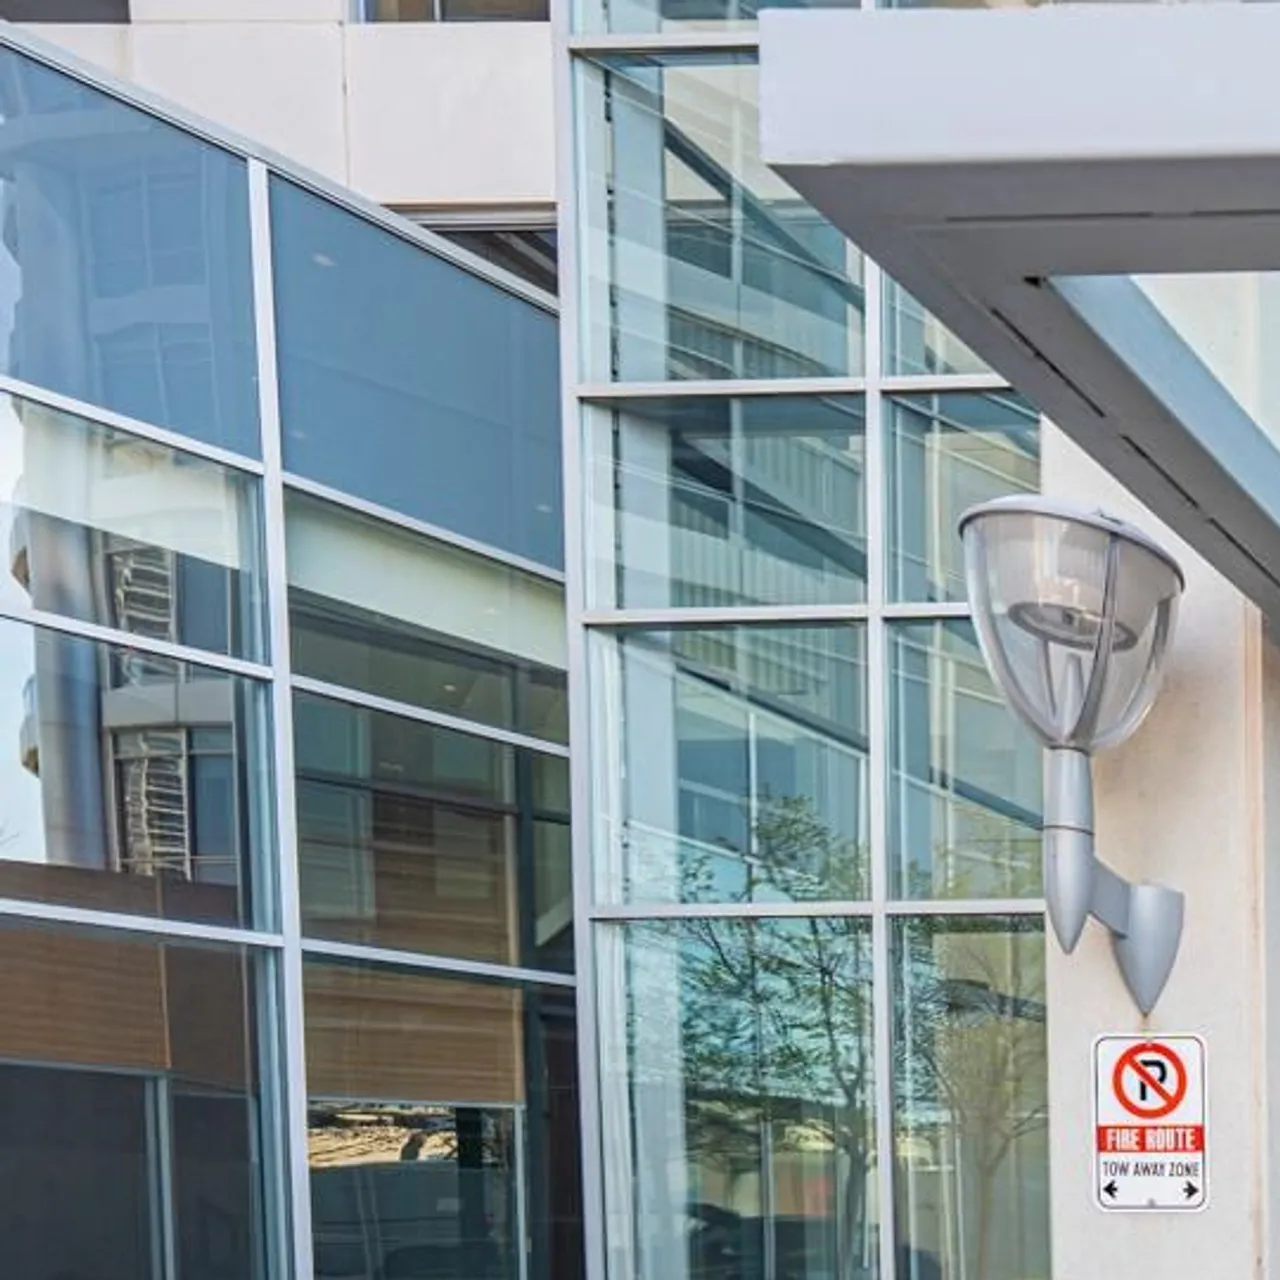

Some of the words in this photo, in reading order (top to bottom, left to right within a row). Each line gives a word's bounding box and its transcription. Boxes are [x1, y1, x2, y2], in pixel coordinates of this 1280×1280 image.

[1106, 1128, 1140, 1150] FIRE
[1145, 1128, 1196, 1150] ROUTE
[1103, 1161, 1130, 1177] TOW
[1133, 1161, 1165, 1177] AWAY
[1168, 1161, 1199, 1177] ZONE
